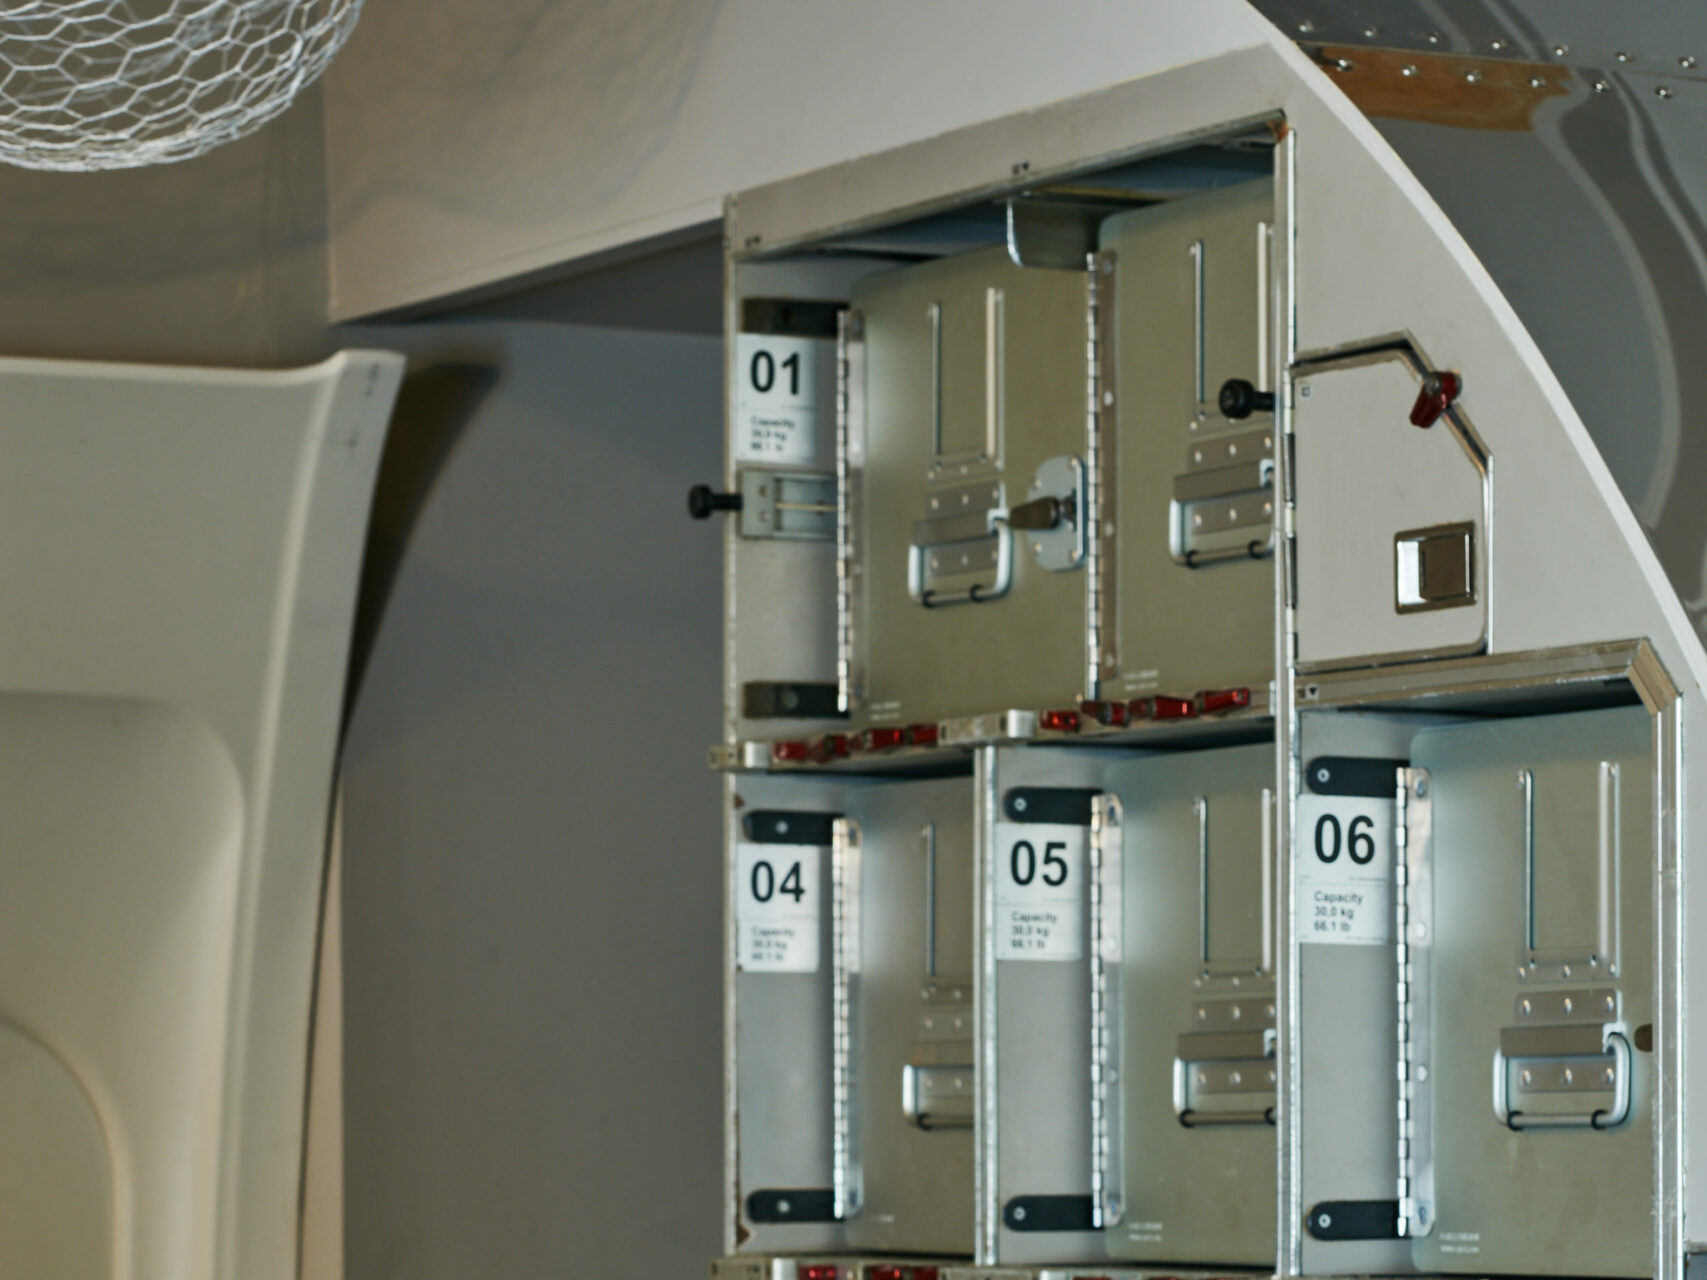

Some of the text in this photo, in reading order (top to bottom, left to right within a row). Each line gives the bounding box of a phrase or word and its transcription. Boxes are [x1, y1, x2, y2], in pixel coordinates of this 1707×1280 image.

[750, 350, 801, 395] 01
[1314, 814, 1375, 864] 06
[1010, 840, 1068, 886] 05
[751, 860, 805, 903] 04
[1314, 891, 1363, 905] Capacity
[1011, 911, 1057, 923] Capacity
[1340, 907, 1354, 919] kg
[1340, 921, 1351, 932] lb
